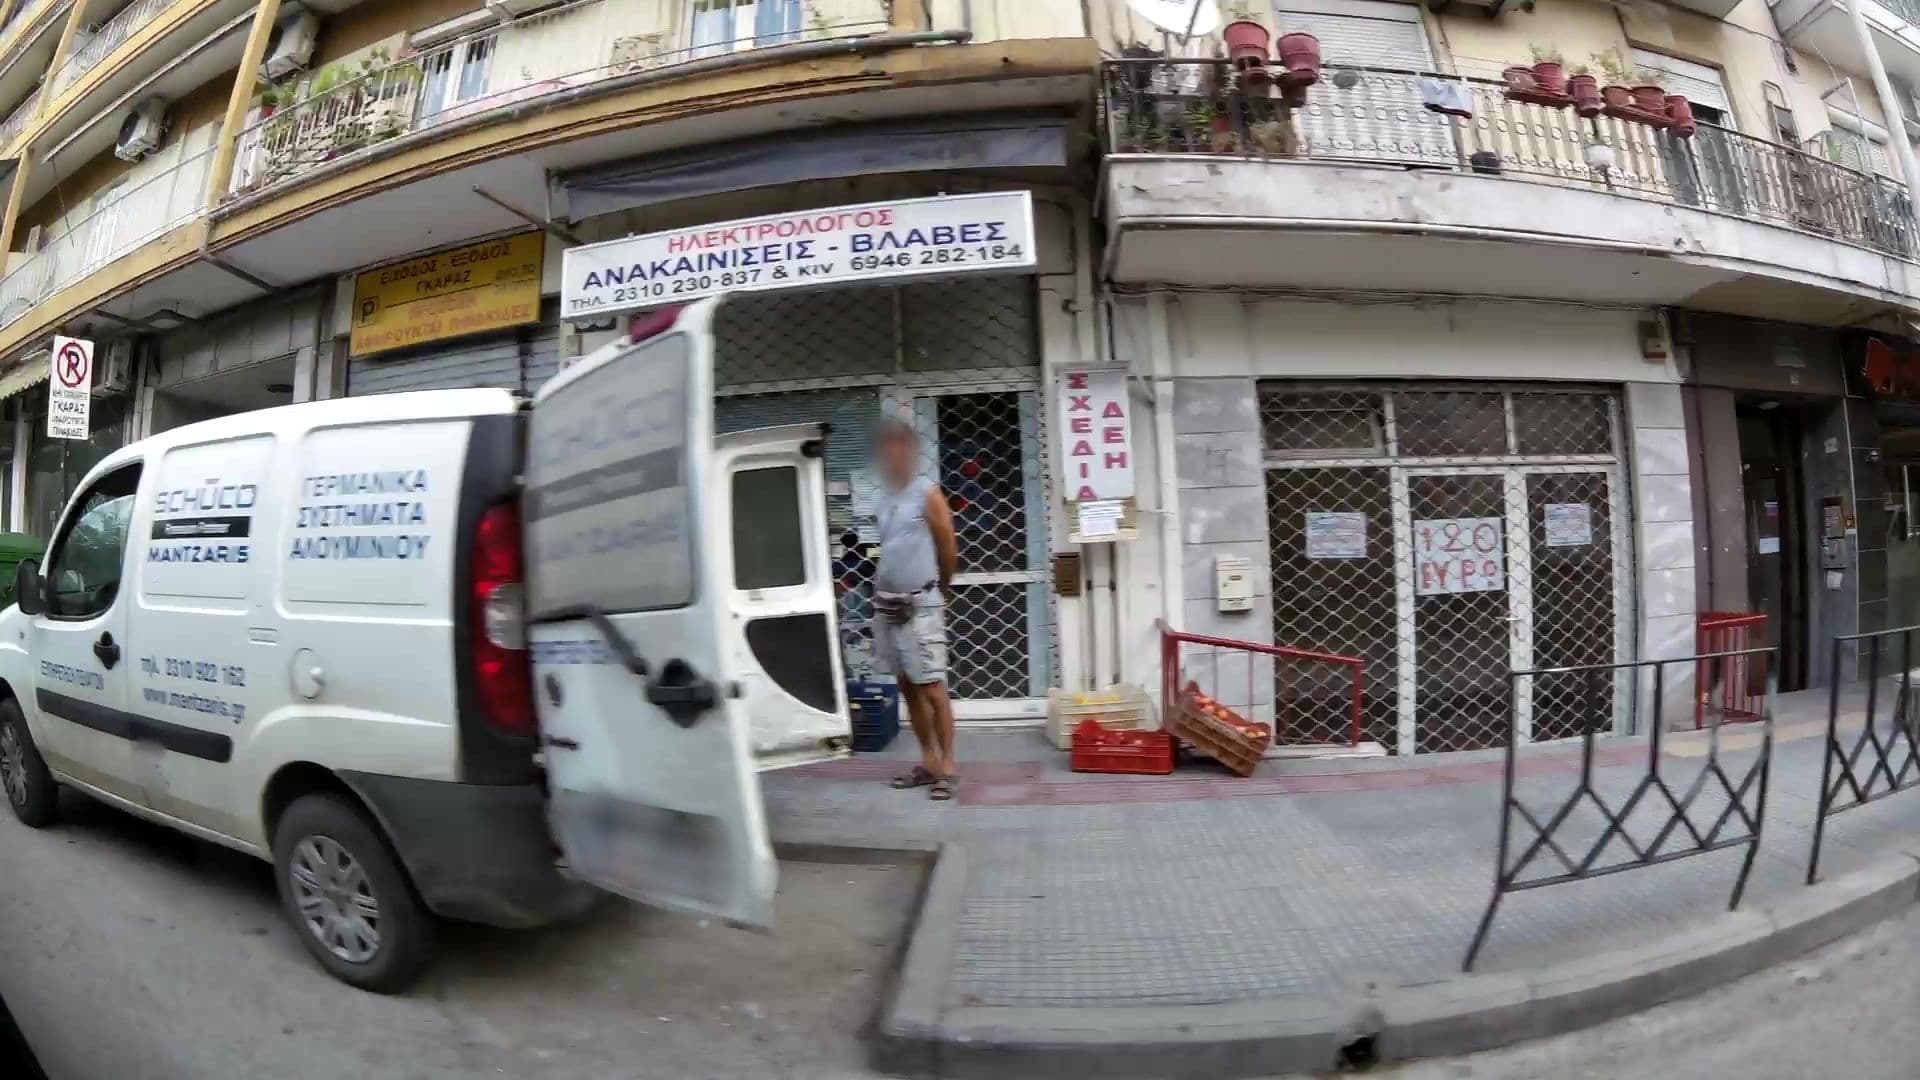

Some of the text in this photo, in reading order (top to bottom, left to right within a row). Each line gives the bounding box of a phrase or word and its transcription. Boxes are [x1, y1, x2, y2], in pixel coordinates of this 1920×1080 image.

[668, 208, 893, 254] ΗΛΕΚΤΡΟΛΟΓΟΣ
[450, 242, 513, 268] ΕΞΟΔΟΣ
[583, 239, 816, 291] ΑΝΑΚΑΙΝΙΣΕΙΣ
[850, 221, 1008, 254] ΒΛΑΒΕΣ
[416, 269, 473, 294] ΓΚΑΡΑΖ
[613, 282, 665, 304] 2310
[671, 268, 762, 295] 230-837
[772, 265, 789, 281] &
[850, 251, 912, 272] 6946
[920, 243, 1023, 266] 282-184
[53, 400, 85, 415] ΓΚΑΡΑΖ
[154, 477, 257, 514] SCHÜCO
[302, 468, 428, 497] ΓΕΡΜΑΝΙΚΑ
[296, 501, 426, 528] ΣΥΣΤΗΜΑΤΑ
[147, 545, 250, 563] MANTZARIS
[289, 535, 430, 559] ΑΛΟΥΜΙΝΙΟΥ
